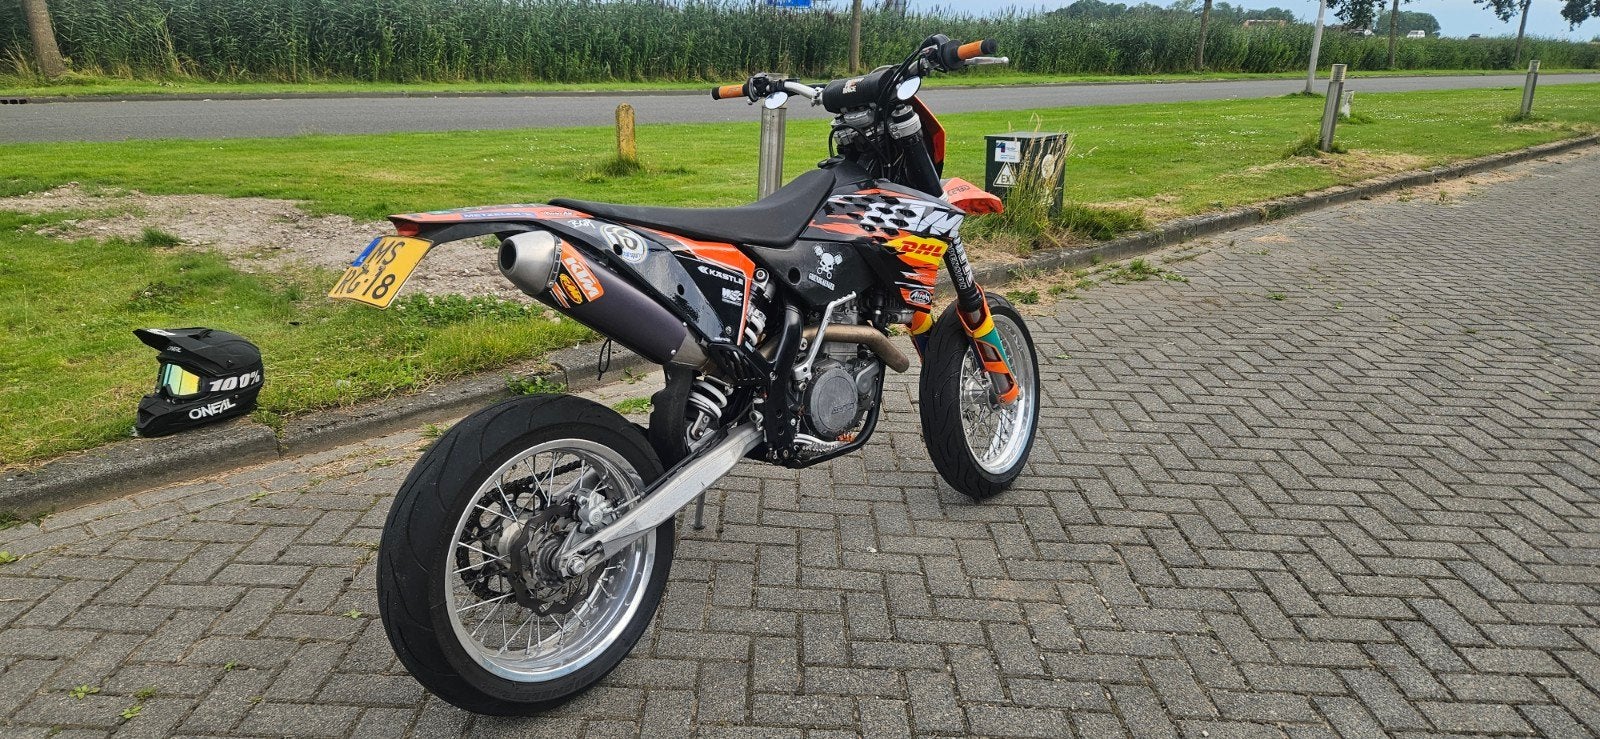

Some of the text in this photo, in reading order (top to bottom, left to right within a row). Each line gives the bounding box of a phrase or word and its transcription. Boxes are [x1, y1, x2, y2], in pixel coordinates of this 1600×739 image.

[1001, 174, 1011, 183] EX
[367, 241, 406, 265] MS
[901, 241, 943, 257] DHL
[565, 257, 600, 298] KTM
[210, 370, 260, 392] 100%
